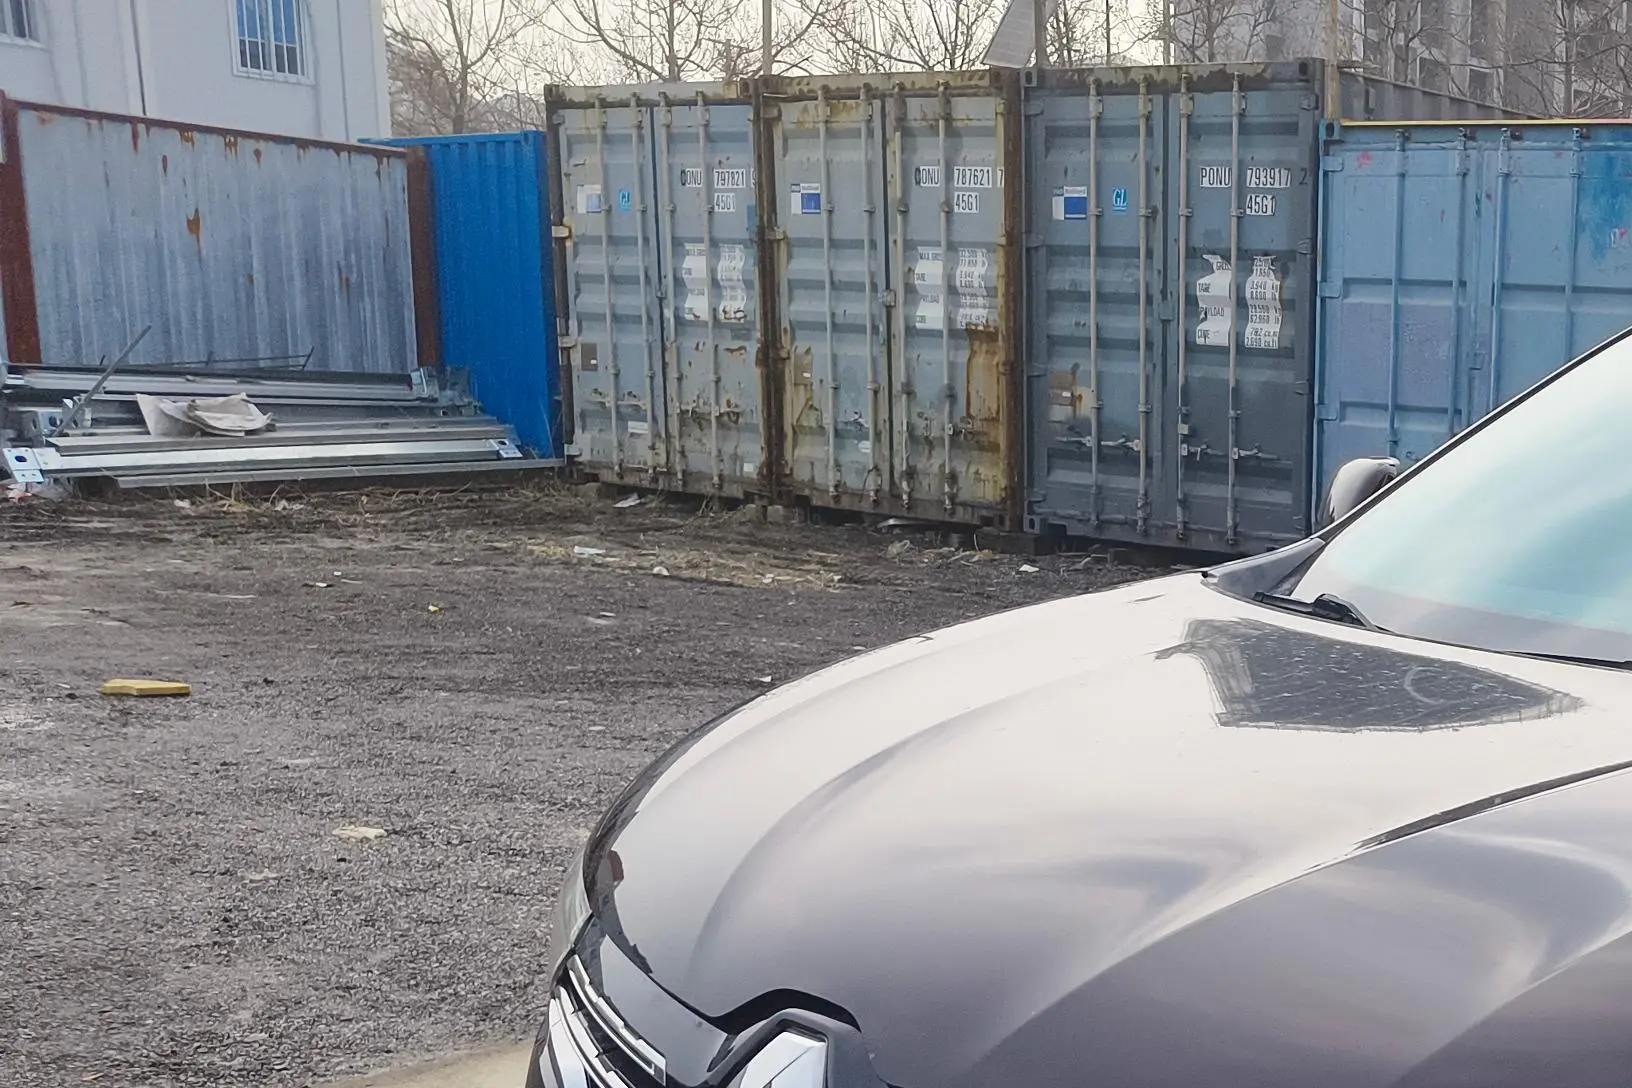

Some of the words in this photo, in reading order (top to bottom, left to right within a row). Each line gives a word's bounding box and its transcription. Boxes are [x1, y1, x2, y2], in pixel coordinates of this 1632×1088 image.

[715, 170, 745, 187] 797821
[955, 168, 990, 186] 787621
[998, 168, 1004, 186] 7
[1200, 167, 1231, 186] PONU
[1247, 167, 1291, 186] 793917
[1298, 167, 1309, 186] 2
[955, 193, 978, 211] 45G1
[1113, 188, 1127, 206] GL
[1247, 194, 1276, 215] 45G1
